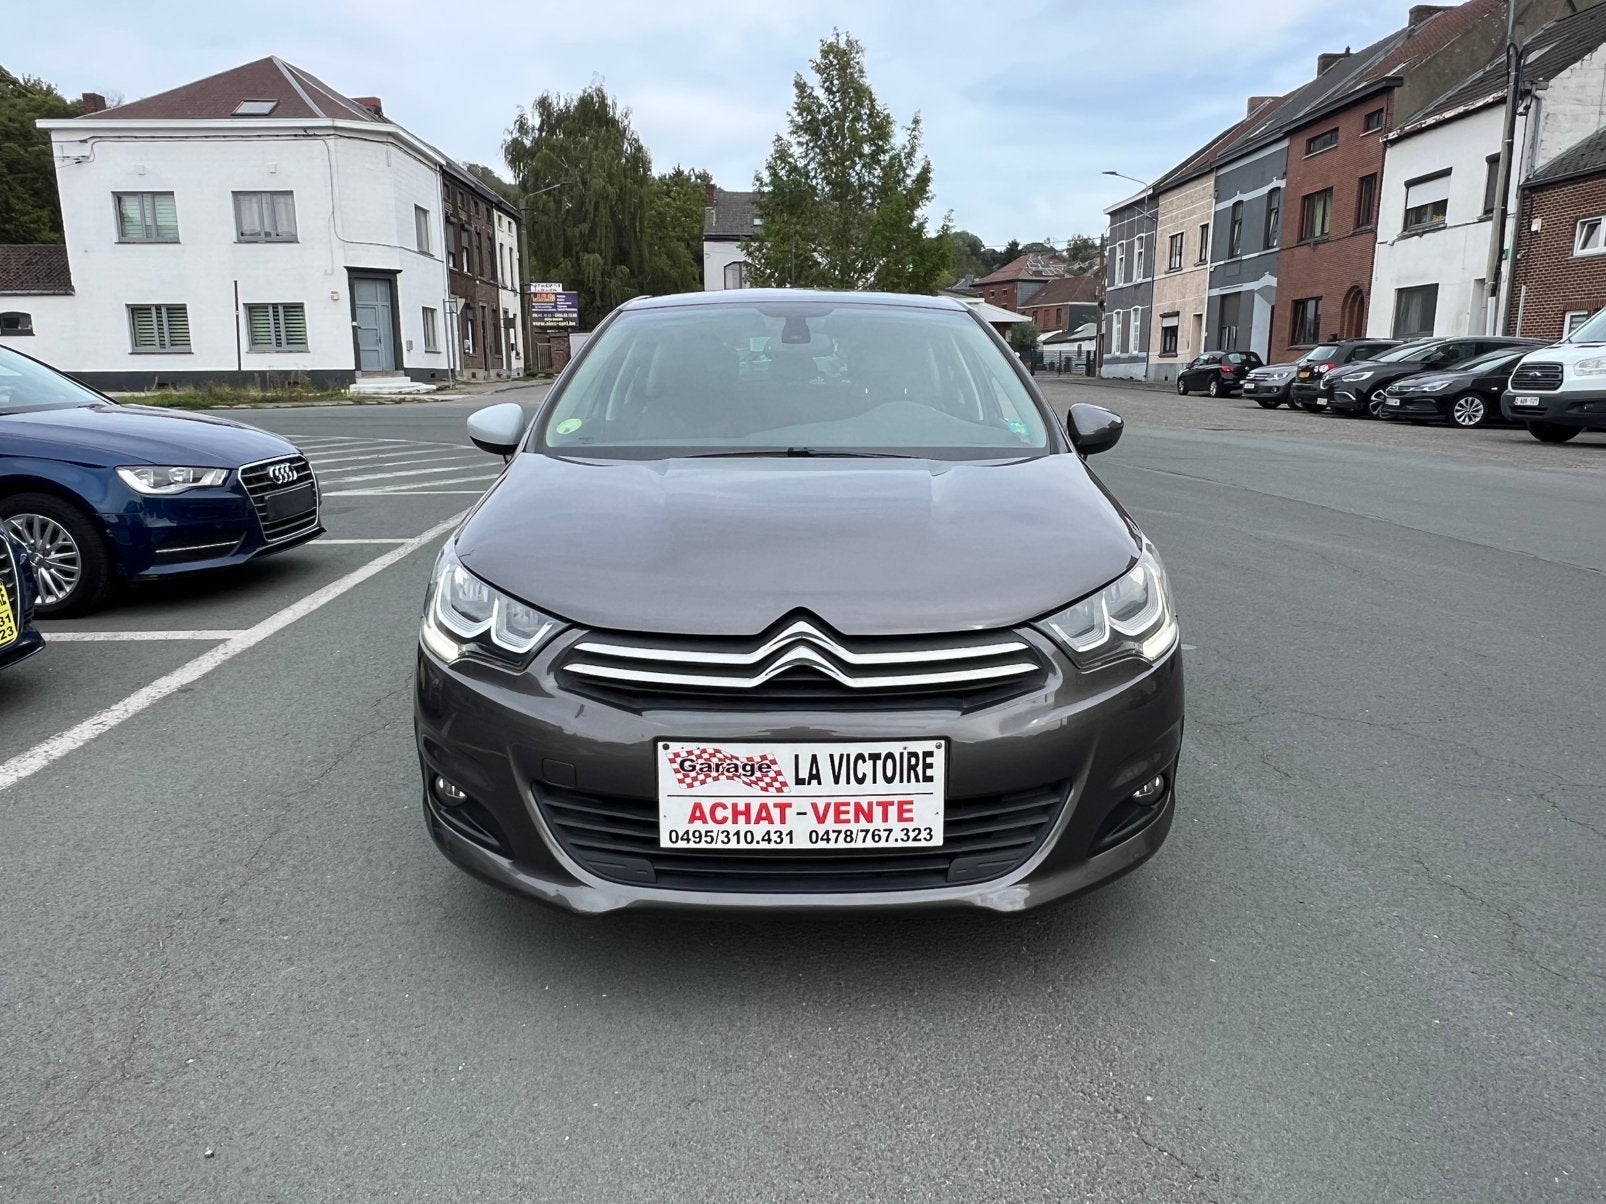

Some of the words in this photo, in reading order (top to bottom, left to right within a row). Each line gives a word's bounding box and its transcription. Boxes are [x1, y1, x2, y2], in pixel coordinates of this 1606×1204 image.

[679, 758, 773, 777] Garage
[794, 753, 822, 786] LA
[829, 750, 934, 785] VICTOIRE
[669, 829, 794, 845] 0495/310.431
[809, 827, 934, 844] 0478/767.323
